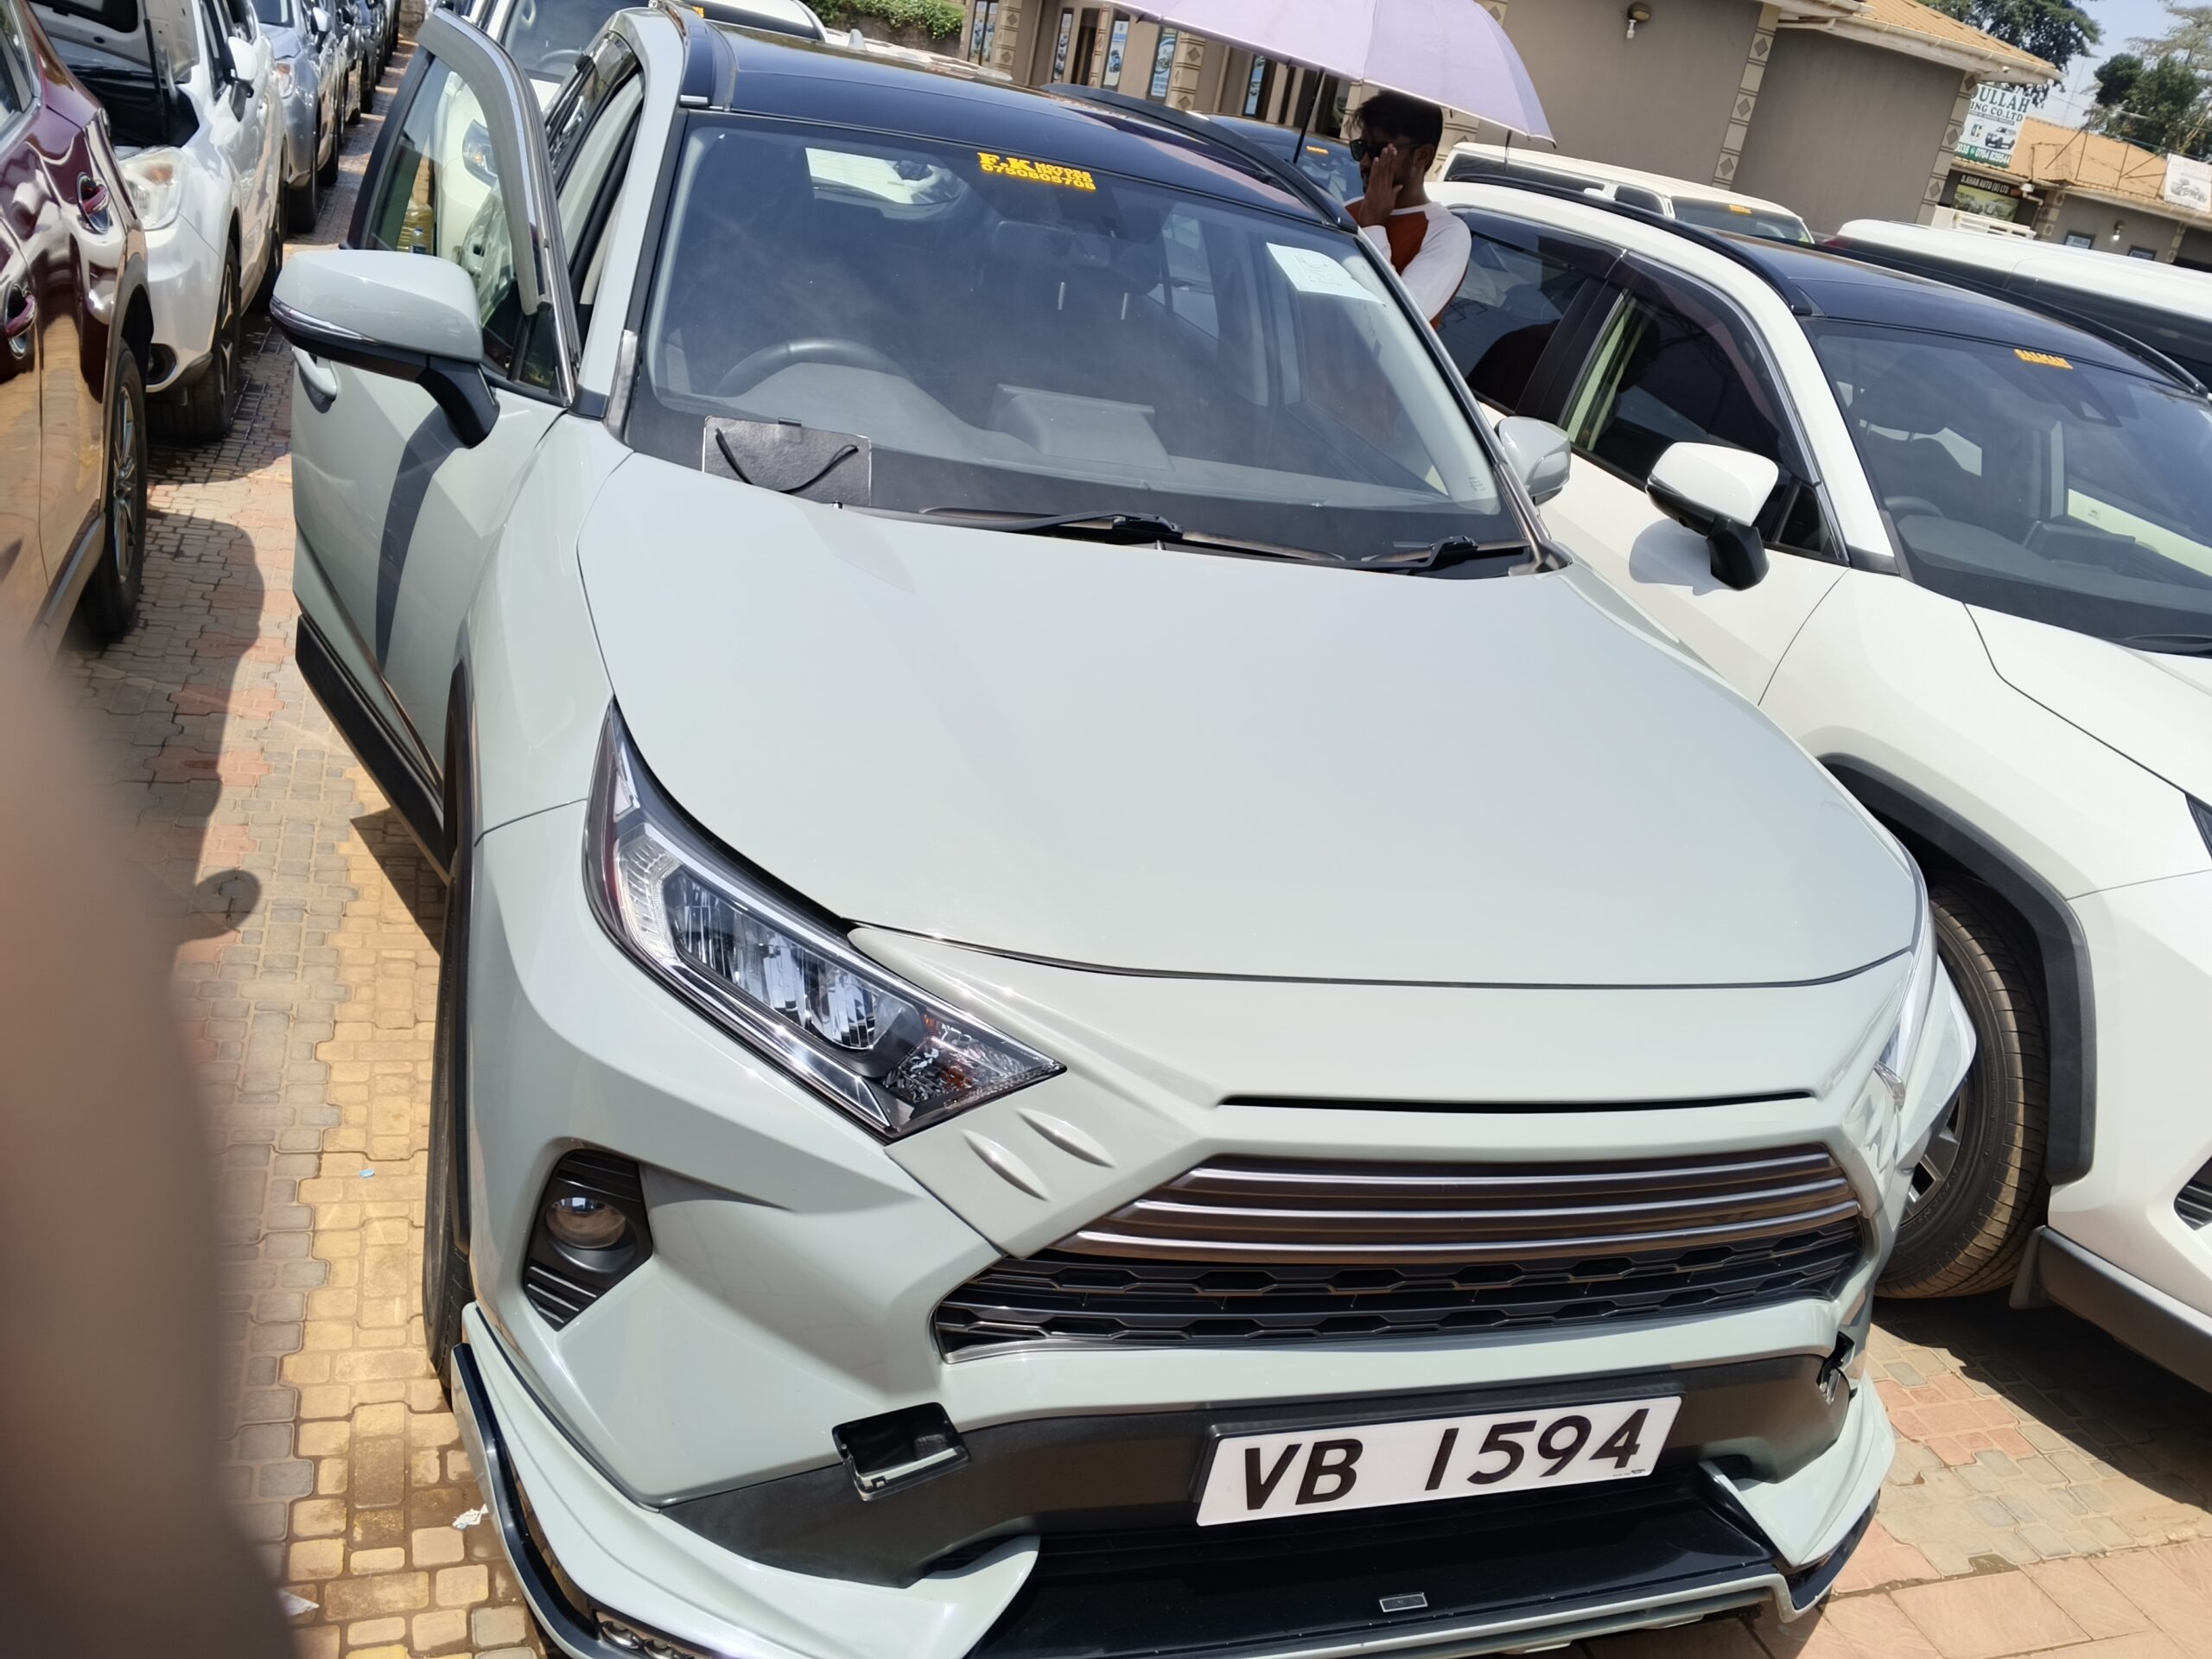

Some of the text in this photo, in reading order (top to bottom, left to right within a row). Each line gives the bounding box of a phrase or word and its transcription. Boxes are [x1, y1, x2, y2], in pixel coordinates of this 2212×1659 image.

[977, 152, 1036, 172] F.K
[1979, 179, 1993, 190] AUTO
[1999, 184, 2010, 194] LTD
[1244, 1408, 1649, 1510] VB 1594
